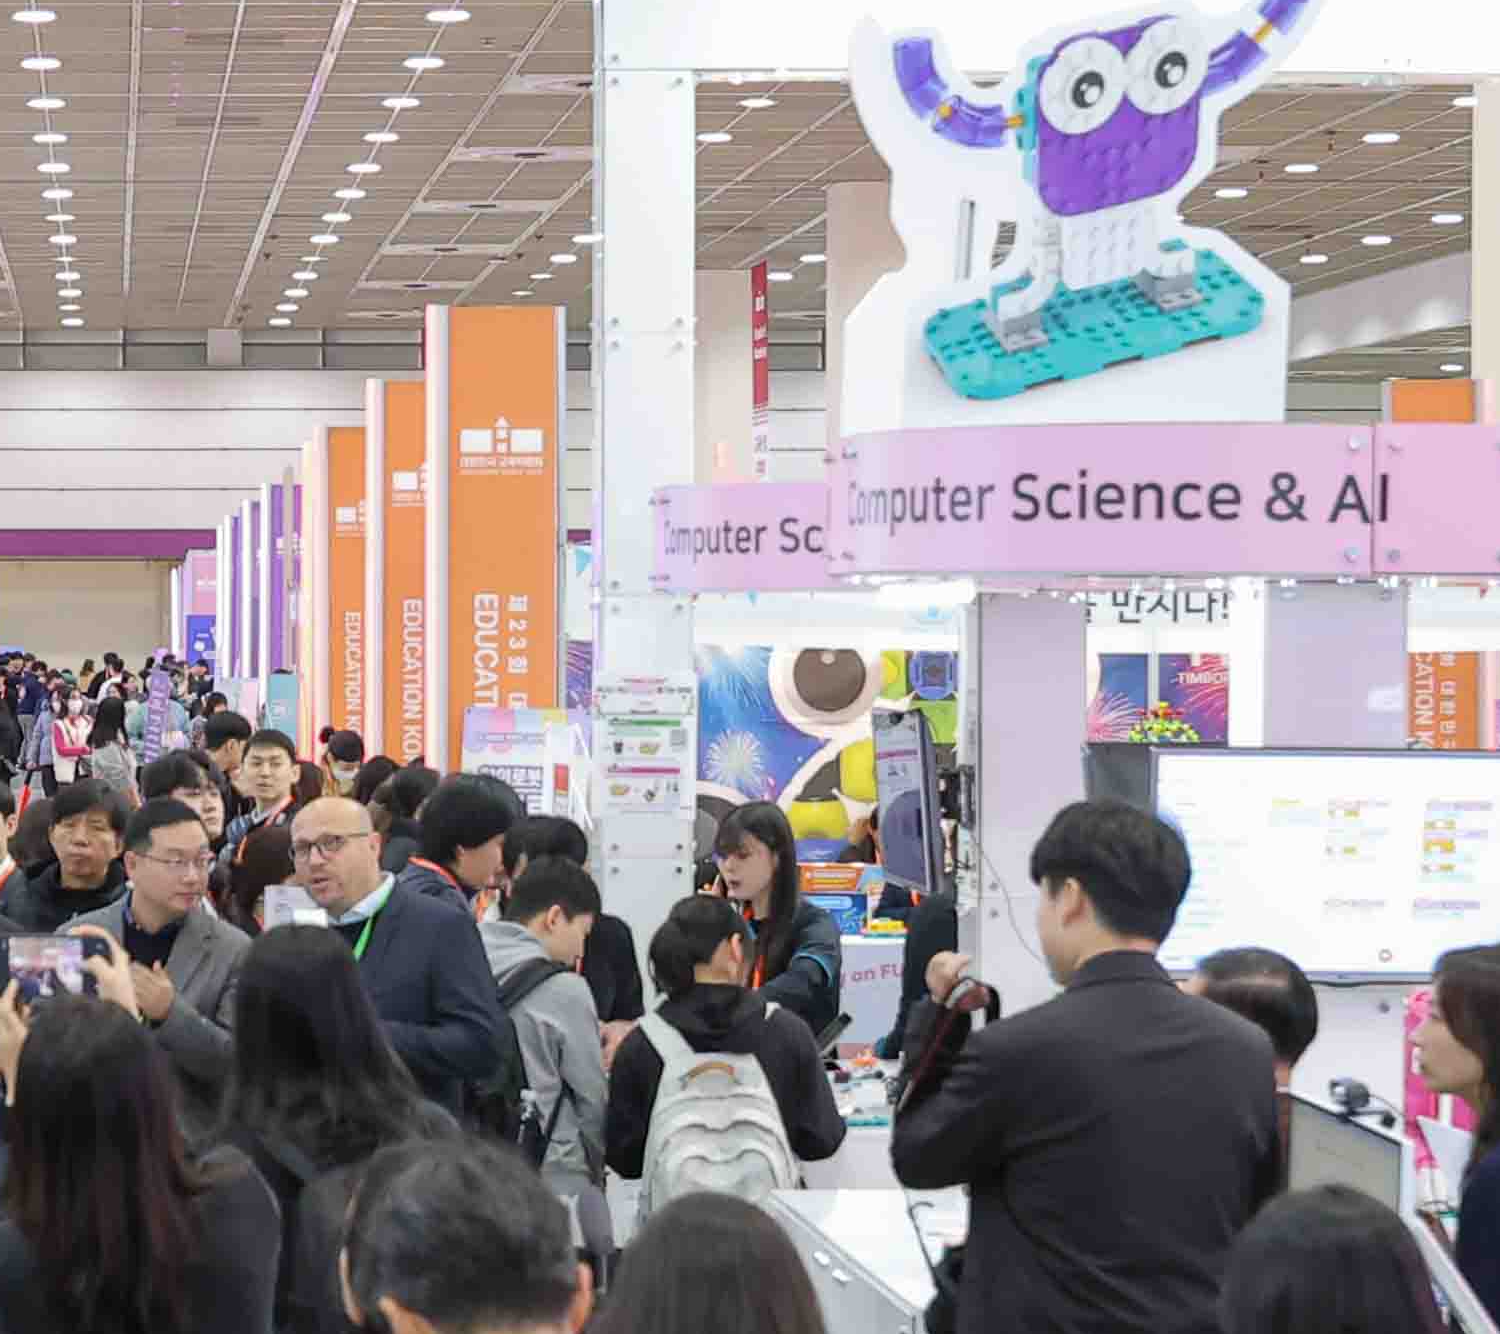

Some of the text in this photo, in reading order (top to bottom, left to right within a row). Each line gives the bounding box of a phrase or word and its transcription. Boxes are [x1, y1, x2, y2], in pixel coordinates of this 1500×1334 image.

[1011, 468, 1241, 522] Science
[1263, 471, 1306, 523] &
[1328, 473, 1390, 524] AI
[473, 592, 500, 708] EDUCATI
